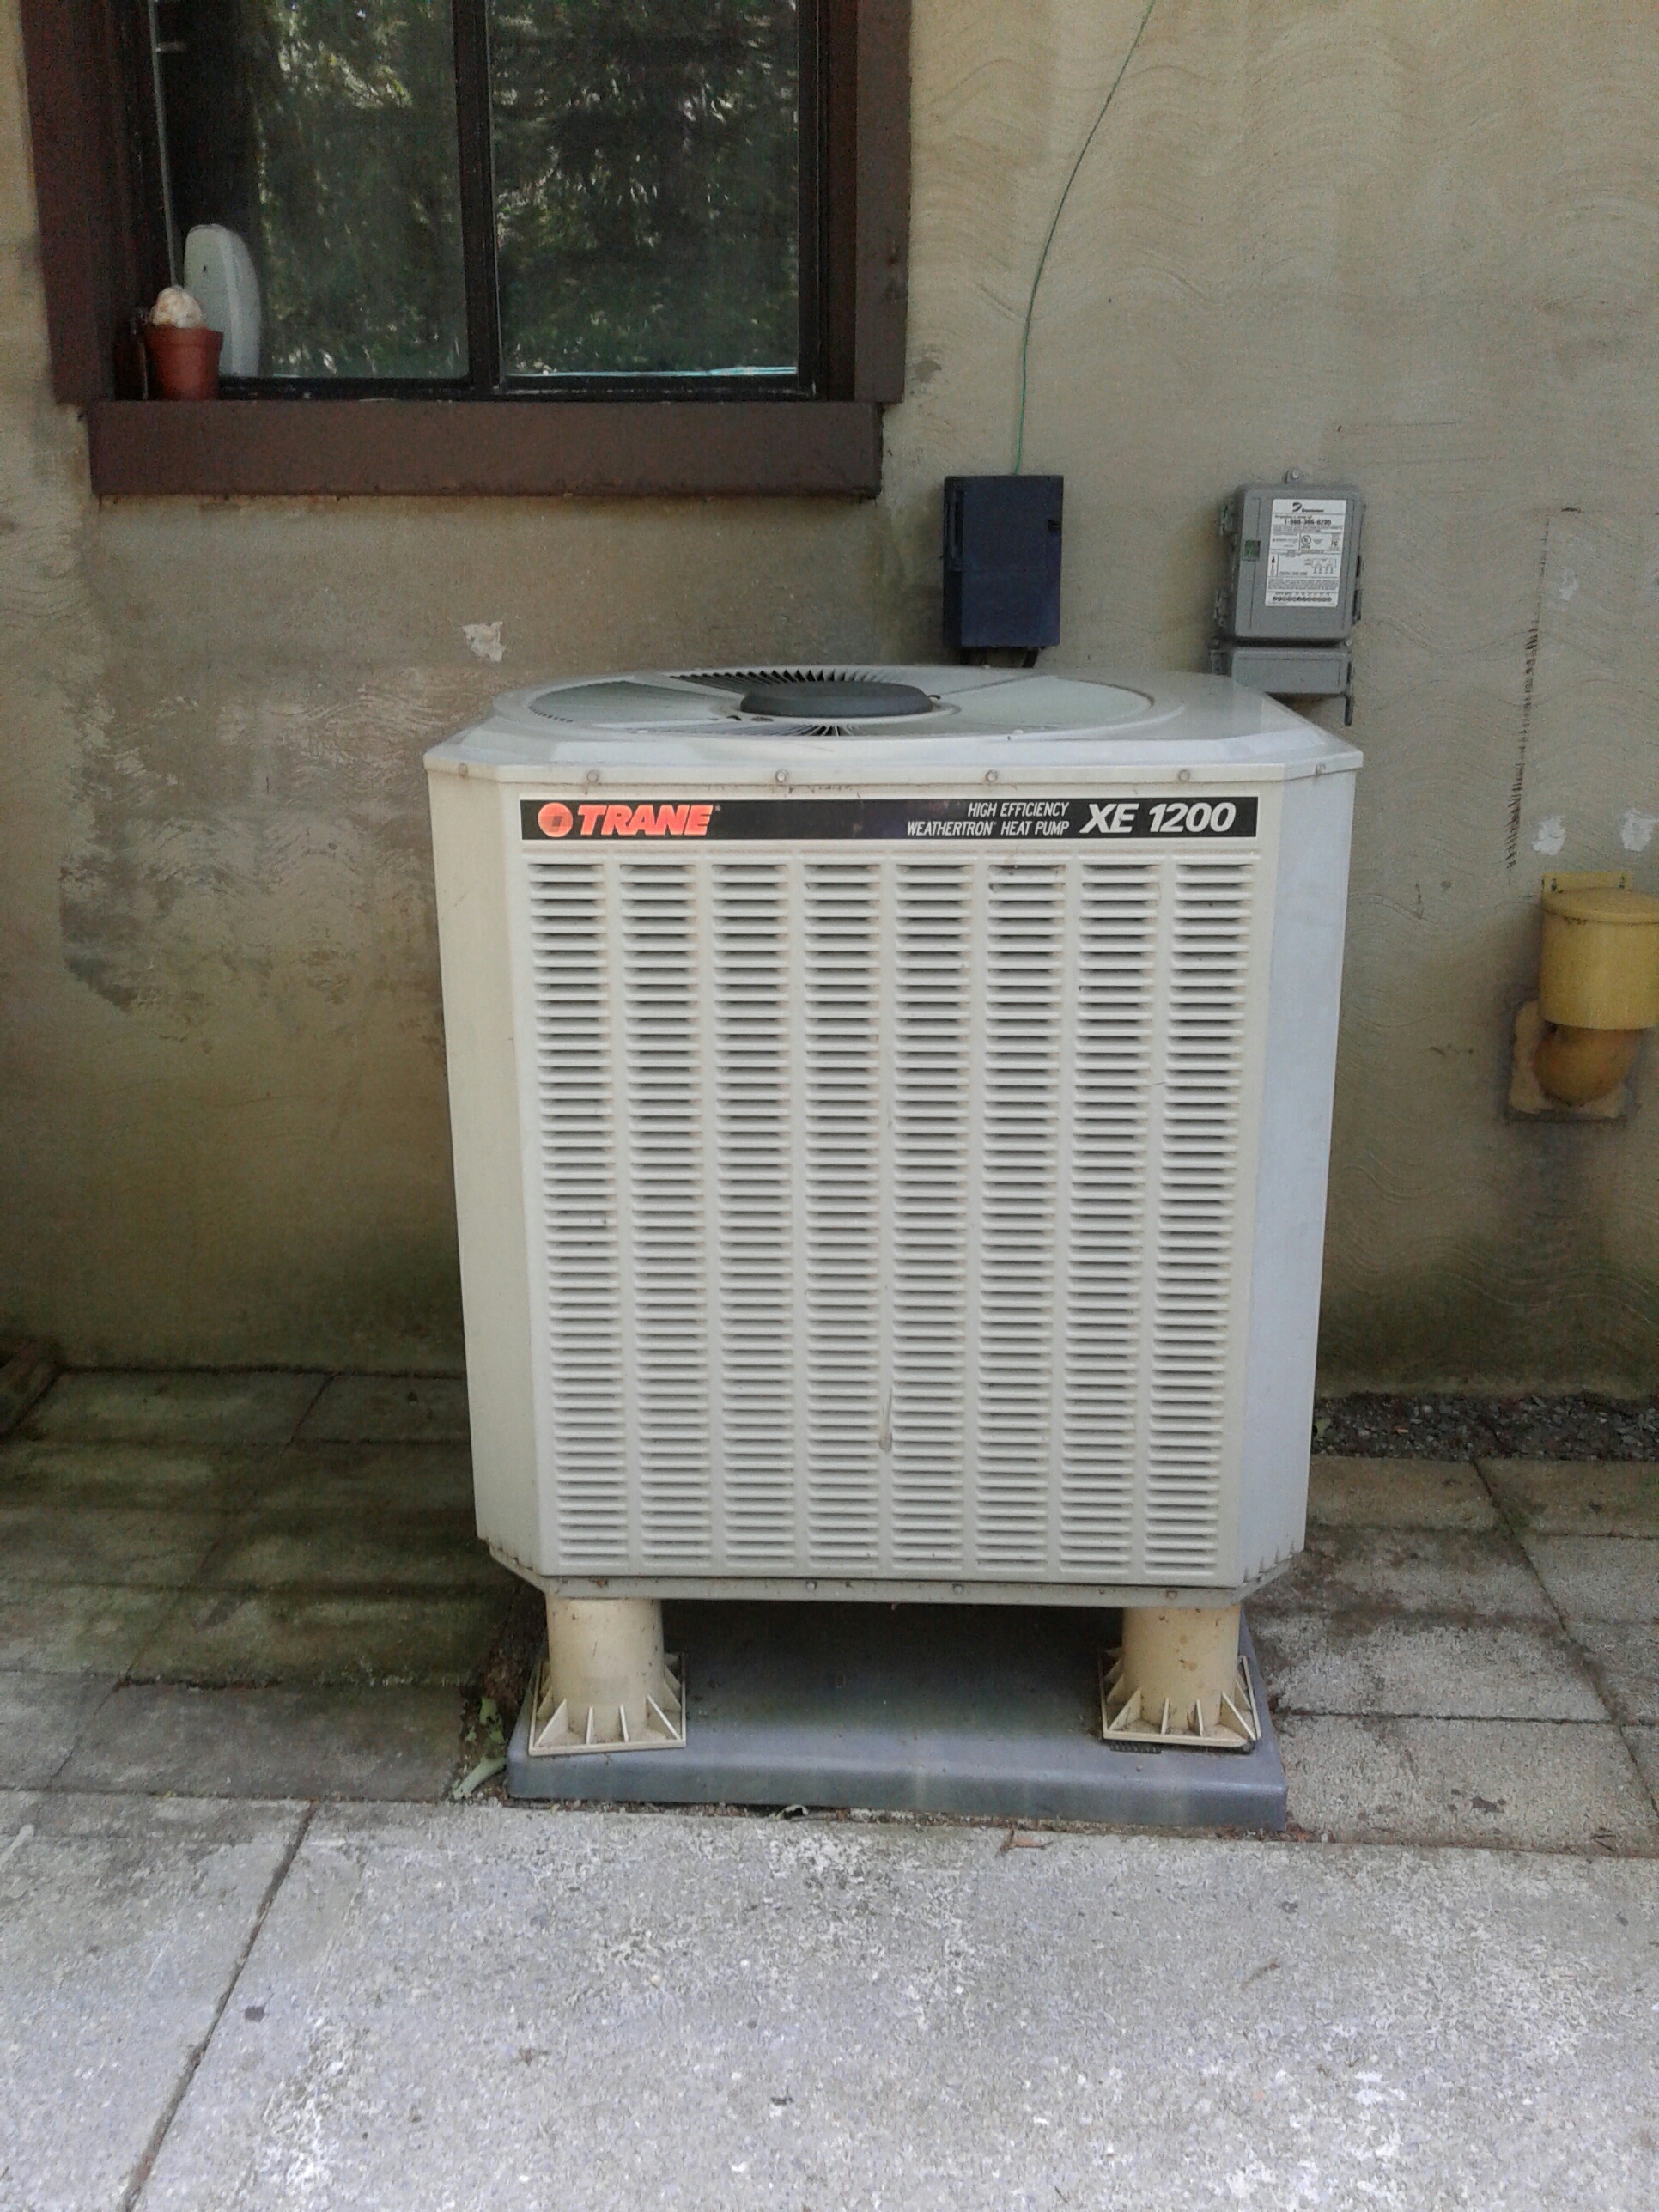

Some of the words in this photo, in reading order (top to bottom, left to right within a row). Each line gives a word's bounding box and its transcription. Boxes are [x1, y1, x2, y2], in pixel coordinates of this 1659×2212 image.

[577, 805, 714, 836] TRANE
[968, 802, 997, 817] HIGH
[1000, 801, 1070, 817] EFFICIENCY
[1079, 803, 1139, 834] XE
[1149, 802, 1237, 833] 1200
[907, 821, 994, 836] WEATHERTRON
[1000, 820, 1033, 836] HEAT
[1034, 820, 1070, 836] PUMP
